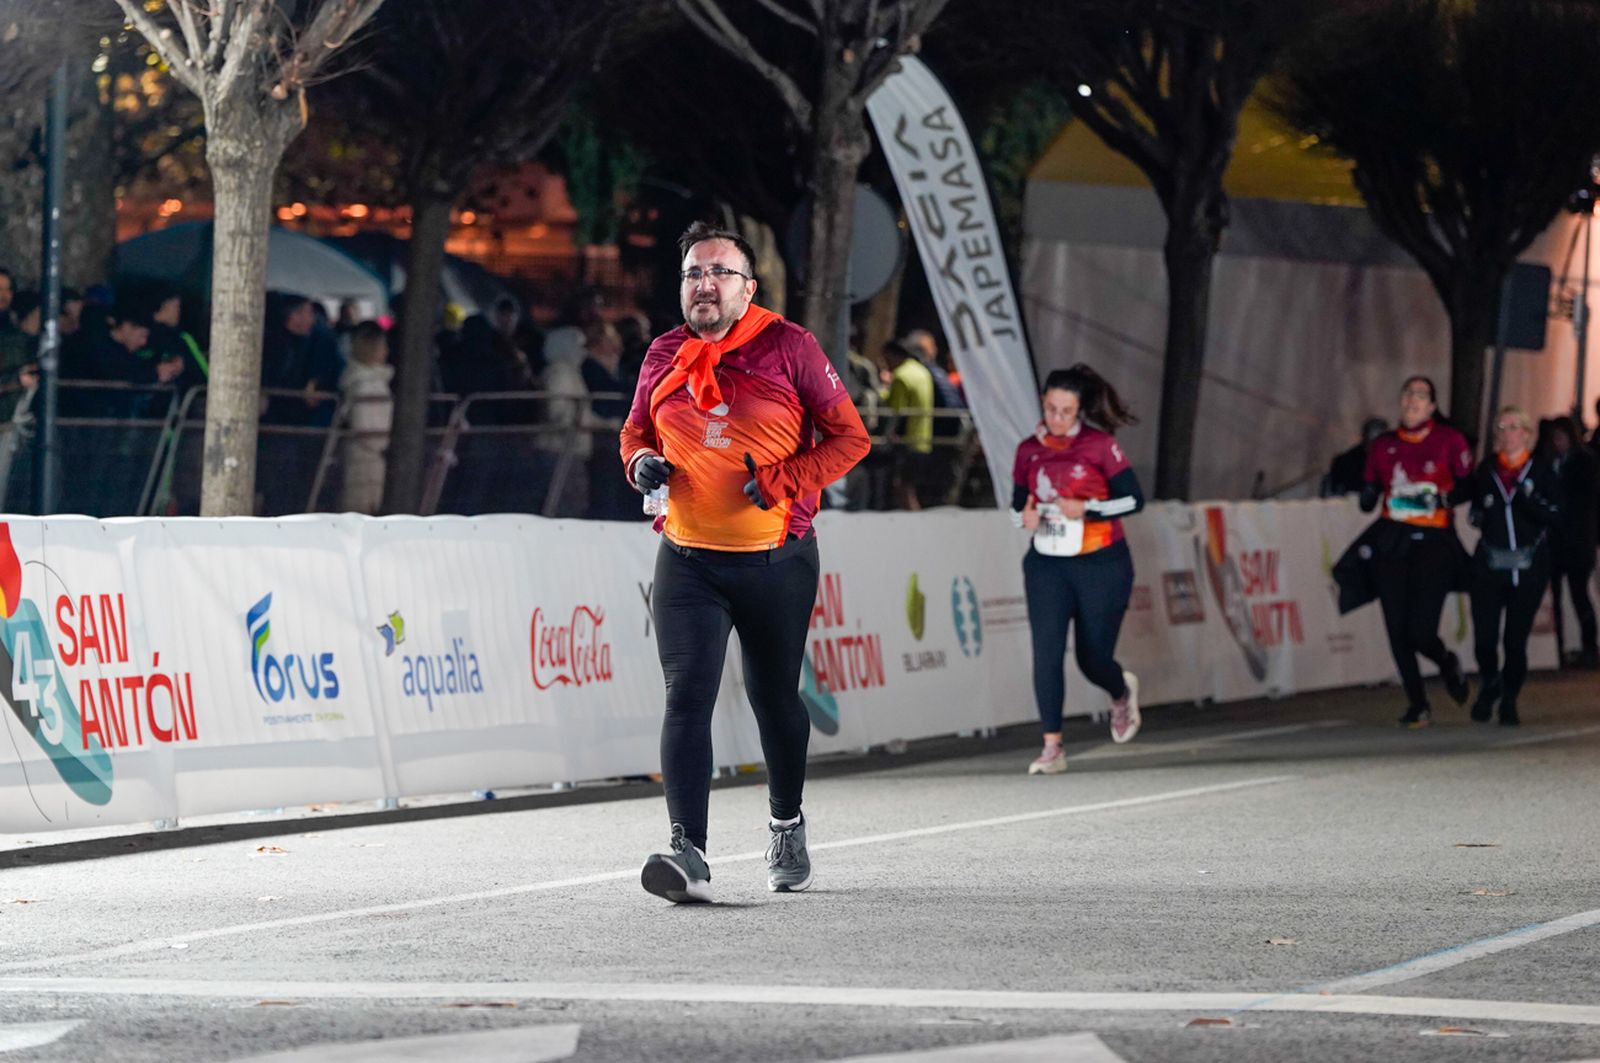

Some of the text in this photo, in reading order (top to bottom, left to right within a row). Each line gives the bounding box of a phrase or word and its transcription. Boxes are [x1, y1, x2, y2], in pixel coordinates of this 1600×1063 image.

[921, 106, 1018, 341] JAPEMASA
[56, 592, 129, 666] SAN
[809, 573, 845, 630] AN
[403, 637, 484, 712] aqualia
[811, 618, 885, 694] ANTÓN
[79, 651, 199, 750] ANTÓN
